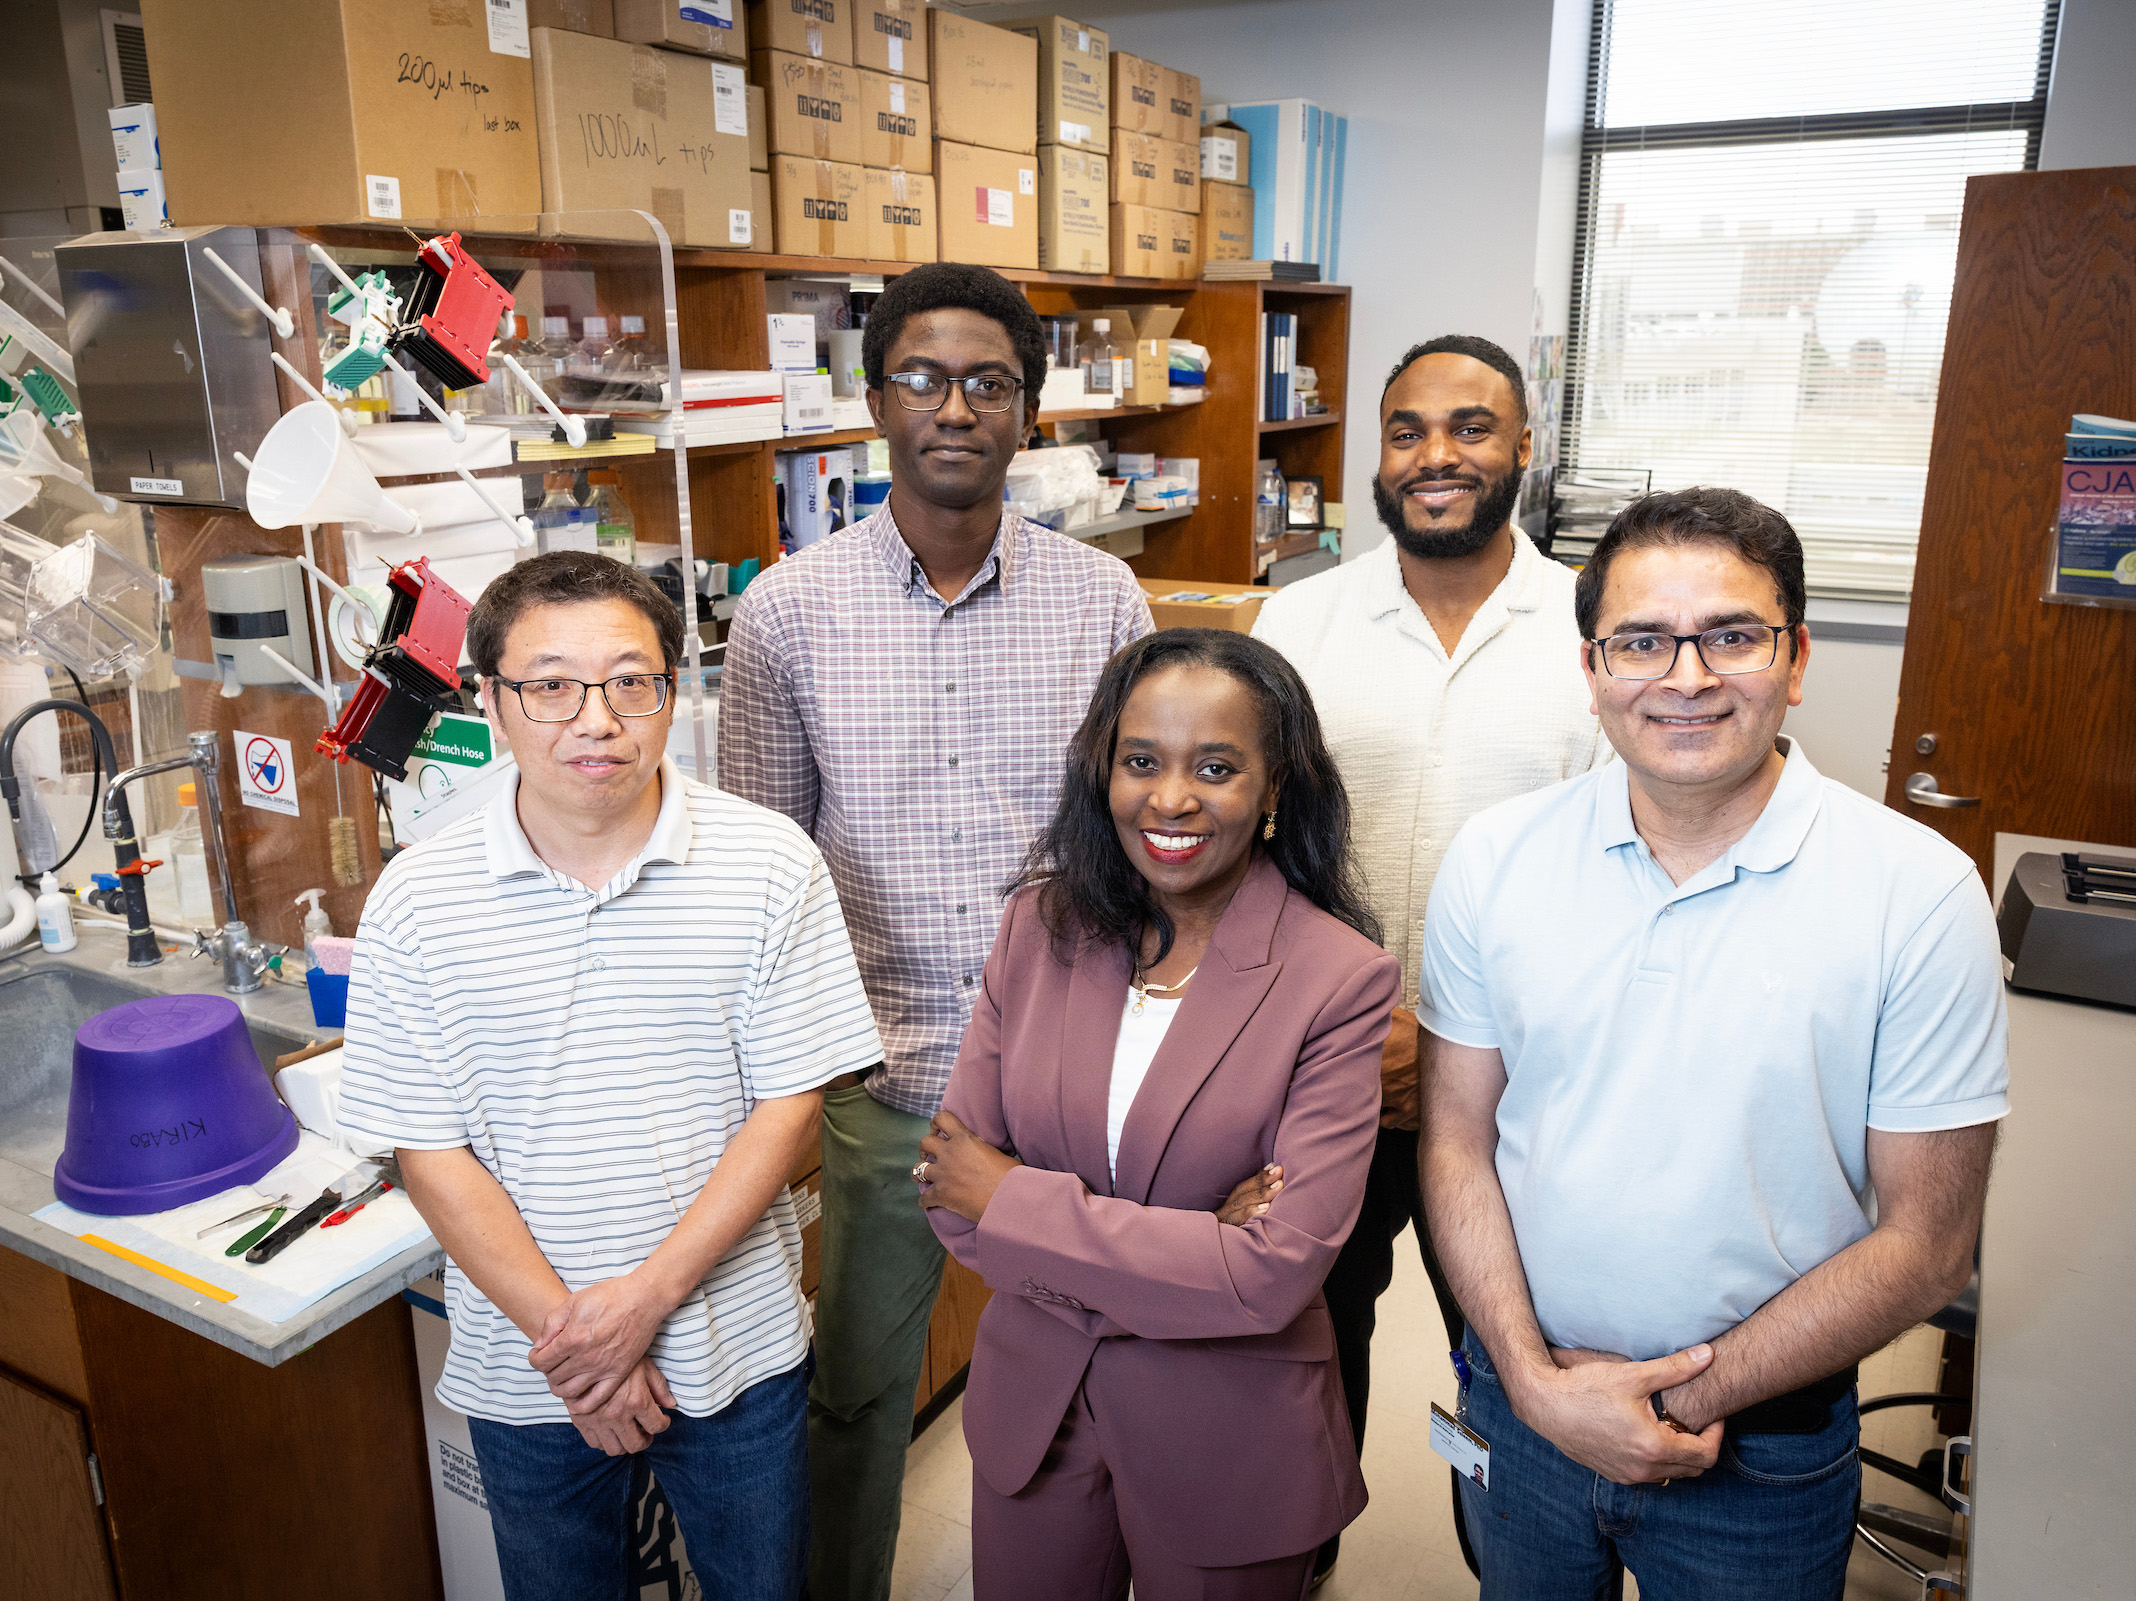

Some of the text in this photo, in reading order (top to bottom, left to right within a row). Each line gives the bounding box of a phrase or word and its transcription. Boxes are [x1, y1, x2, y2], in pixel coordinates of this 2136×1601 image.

[459, 70, 489, 110] tips
[484, 113, 522, 132] last box
[679, 143, 715, 175] tips
[135, 481, 178, 492] PAPER TOWELS
[807, 456, 817, 513] SCION700
[415, 738, 485, 760] sh/Drench Hose
[250, 791, 273, 801] CHEMICAL
[273, 796, 296, 807] DISPOSAL
[130, 1118, 206, 1148] KIRABO
[440, 1444, 451, 1457] Do
[452, 1453, 464, 1465] not
[441, 1456, 449, 1468] in
[449, 1462, 473, 1481] plastic
[442, 1470, 456, 1482] and
[457, 1476, 471, 1490] box
[472, 1486, 480, 1495] at
[443, 1481, 478, 1505] maximum
